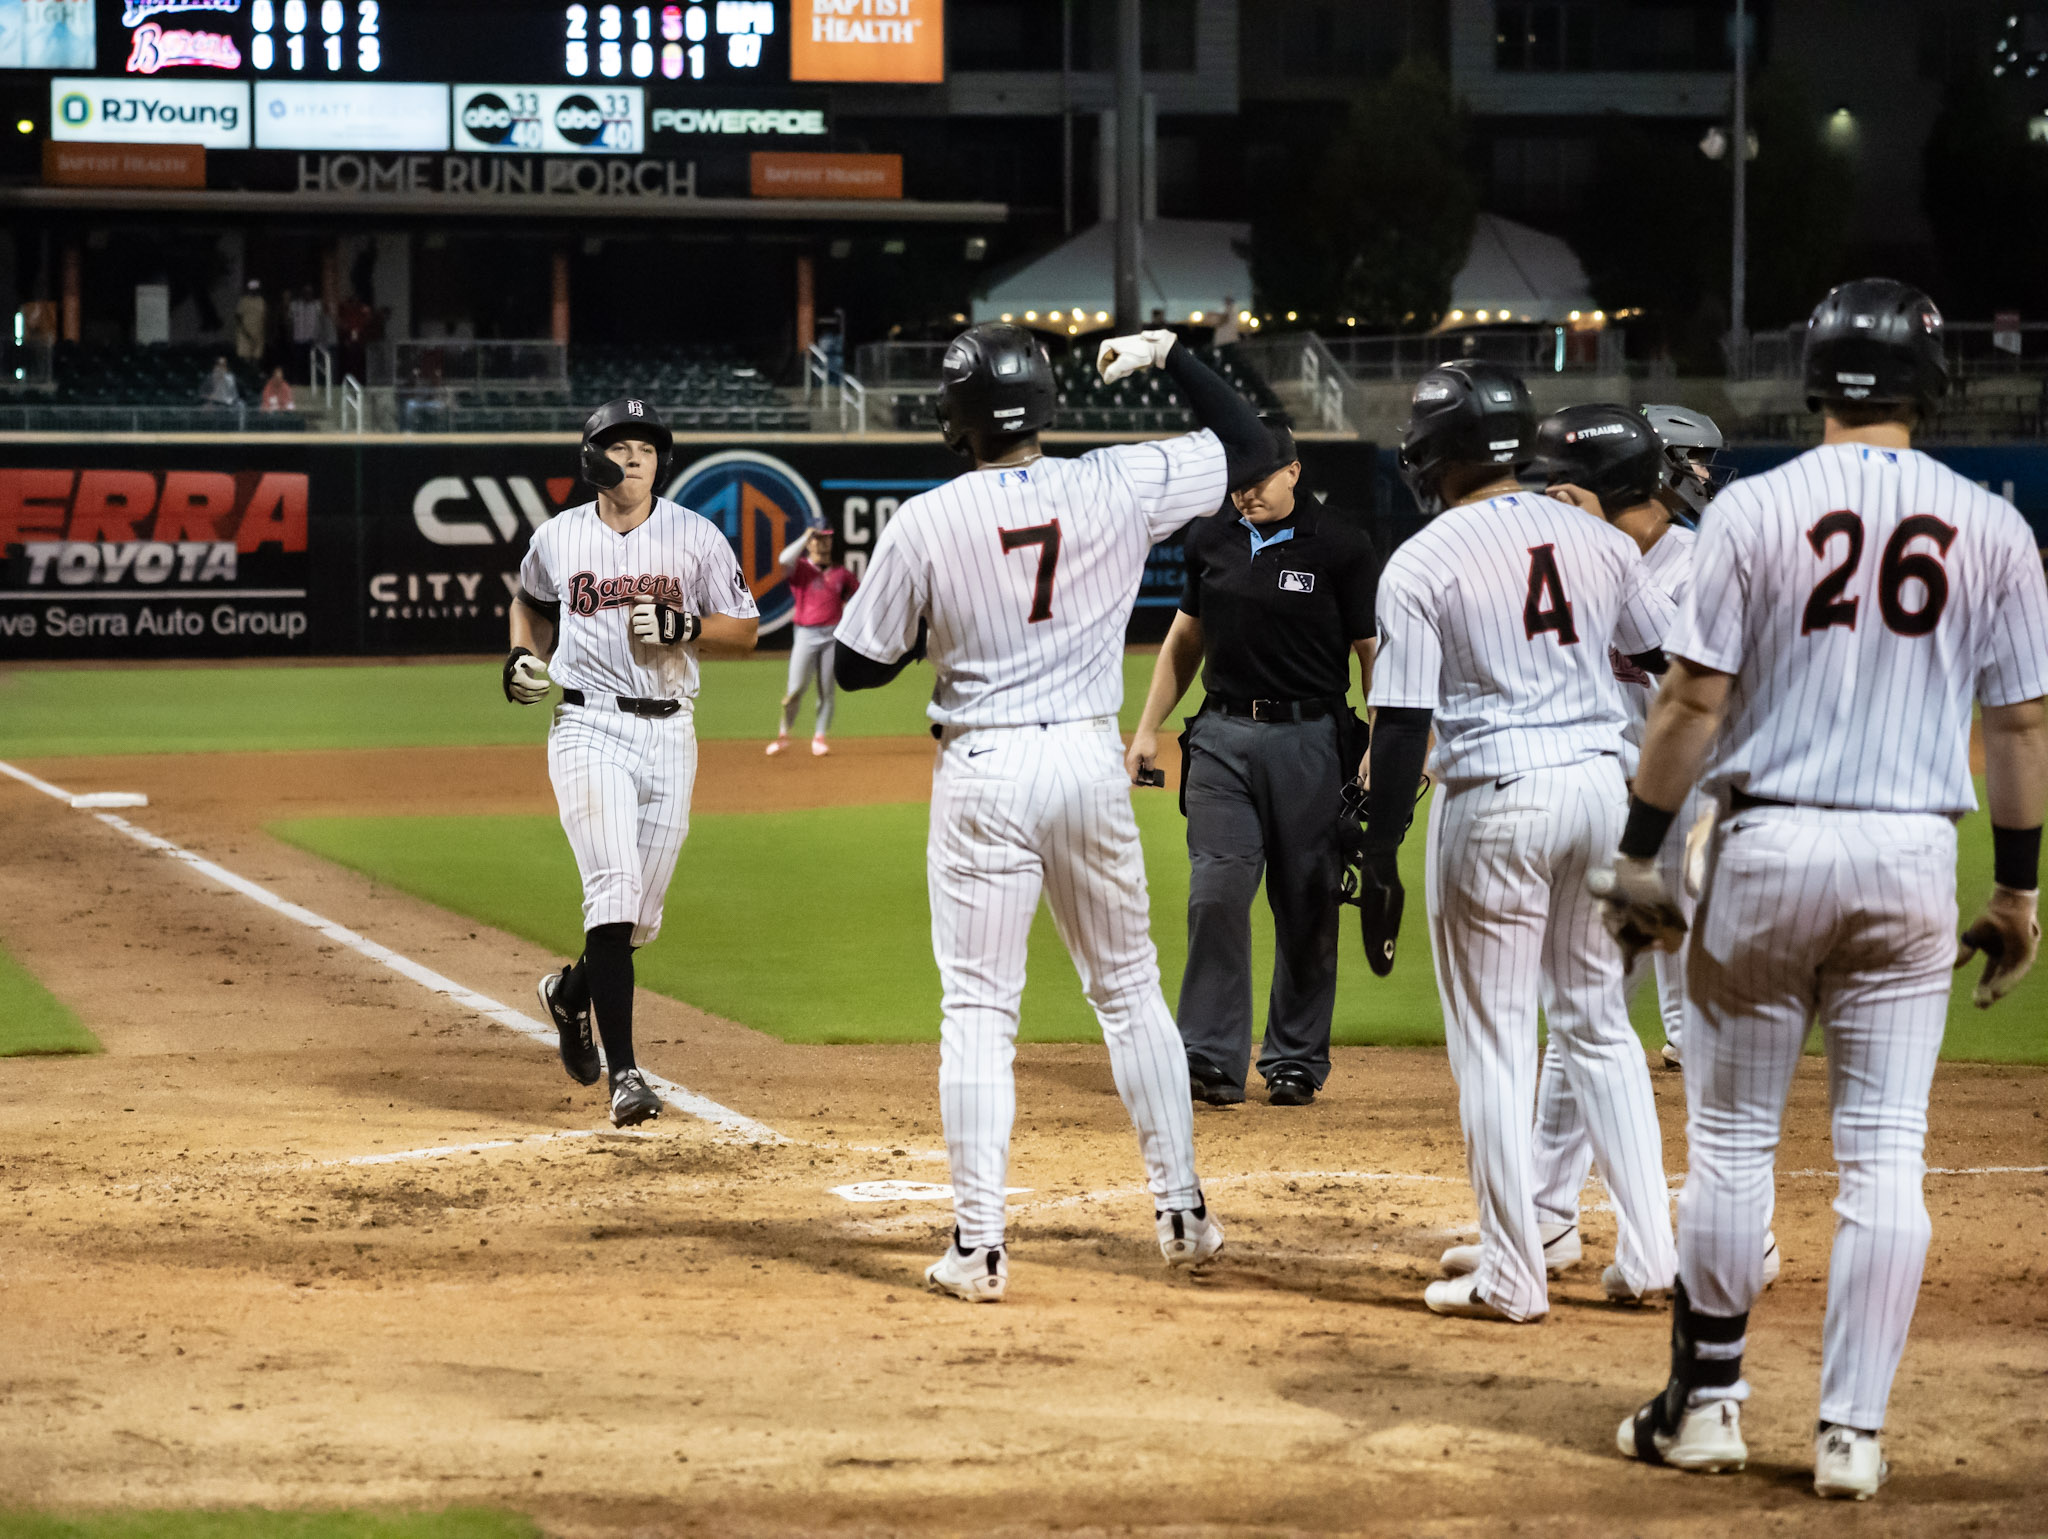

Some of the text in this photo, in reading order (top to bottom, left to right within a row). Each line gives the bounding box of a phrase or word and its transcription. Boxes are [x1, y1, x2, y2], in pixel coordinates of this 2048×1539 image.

[358, 0, 380, 34] 2
[566, 3, 588, 39] 2
[632, 6, 650, 41] 1
[685, 6, 707, 42] 0
[812, 16, 914, 43] HEALTH
[286, 34, 305, 70] 1
[323, 35, 342, 71] 1
[358, 35, 380, 72] 3
[566, 41, 588, 77] 5
[600, 42, 622, 77] 5
[688, 44, 706, 79] 1
[102, 99, 238, 130] RJYoung
[464, 104, 513, 129] abc
[514, 93, 539, 115] 33
[555, 95, 630, 130] abc 33
[653, 109, 827, 134] POWERADE
[511, 121, 541, 149] 40
[601, 122, 632, 150] 40
[299, 155, 696, 198] HOME RUN PORCH
[1577, 423, 1625, 440] STRAUSS
[25, 541, 237, 584] TOYOTA
[997, 517, 1062, 623] 7
[1802, 509, 1959, 637] 26
[369, 573, 482, 602] CITY
[568, 570, 684, 617] Barons
[1524, 542, 1580, 646] 4
[45, 606, 128, 637] Serra
[135, 607, 205, 636] Auto
[211, 605, 307, 639] Group
